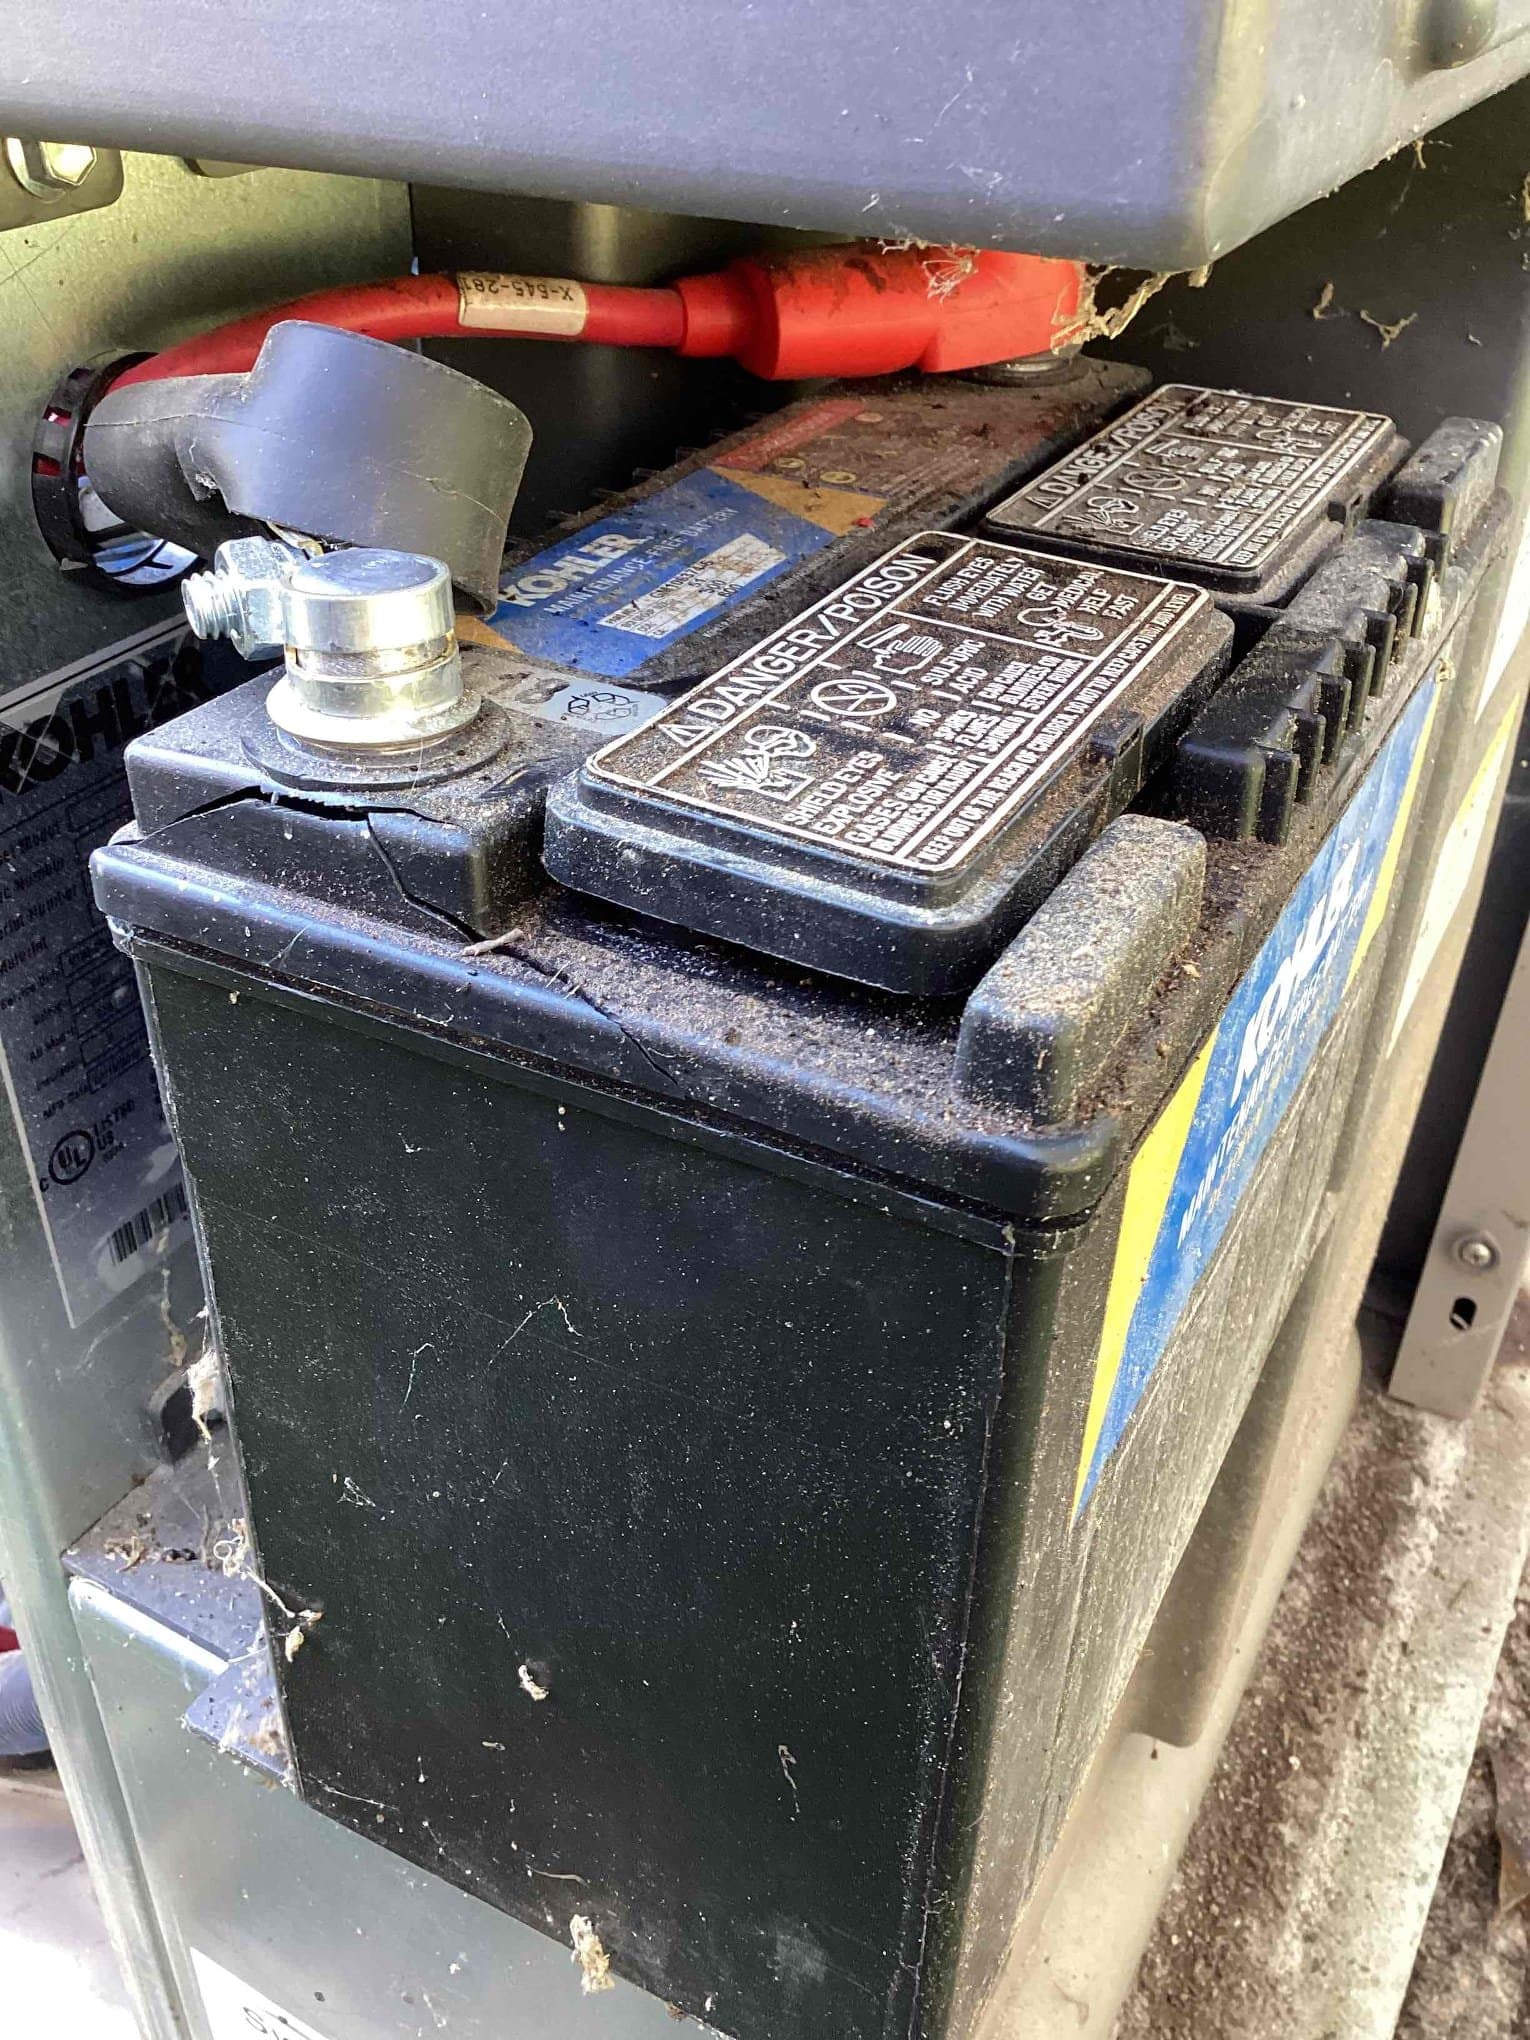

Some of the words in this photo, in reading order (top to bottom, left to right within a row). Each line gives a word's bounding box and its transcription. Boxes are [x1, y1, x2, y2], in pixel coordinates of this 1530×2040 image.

[497, 533, 648, 607] KOHLER
[922, 577, 969, 606] FLUSH
[956, 556, 994, 578] EYES
[947, 556, 1024, 611] IMMEDIATELY
[971, 595, 1011, 617] WITH
[997, 566, 1044, 597] WATER
[1025, 581, 1058, 601] GET
[1050, 570, 1103, 608] MEDICAL
[1076, 587, 1111, 614] HELP
[1101, 593, 1139, 619] FAST
[689, 553, 932, 718] DANGER/POISON
[1116, 640, 1146, 660] CAPS
[920, 638, 985, 685] SULFURIC
[1099, 657, 1129, 677] KEEP
[948, 666, 988, 693] ACID
[977, 682, 1006, 699] CAN
[993, 660, 1031, 684] CAUSE
[998, 665, 1050, 704] BLINDNESS
[1037, 654, 1062, 667] OR
[1019, 680, 1061, 710] SEVERE
[1047, 658, 1083, 683] BURNS
[1063, 700, 1089, 714] DO
[1074, 687, 1102, 703] NOT
[908, 708, 941, 727] NO
[954, 713, 1000, 746] FLAMES
[1014, 749, 1040, 763] OF
[780, 781, 847, 825] SHIELD
[830, 750, 884, 782] EYES
[987, 761, 1030, 790] REACH
[811, 768, 903, 834] EXPLOSIVE
[844, 798, 908, 842] GASES
[895, 780, 928, 800] CAN
[958, 804, 988, 820] OF
[969, 788, 1005, 807] THE
[870, 802, 935, 851] BLINDNESS
[920, 789, 949, 804] OR
[941, 817, 975, 837] OUT
[914, 834, 956, 861] KEEP
